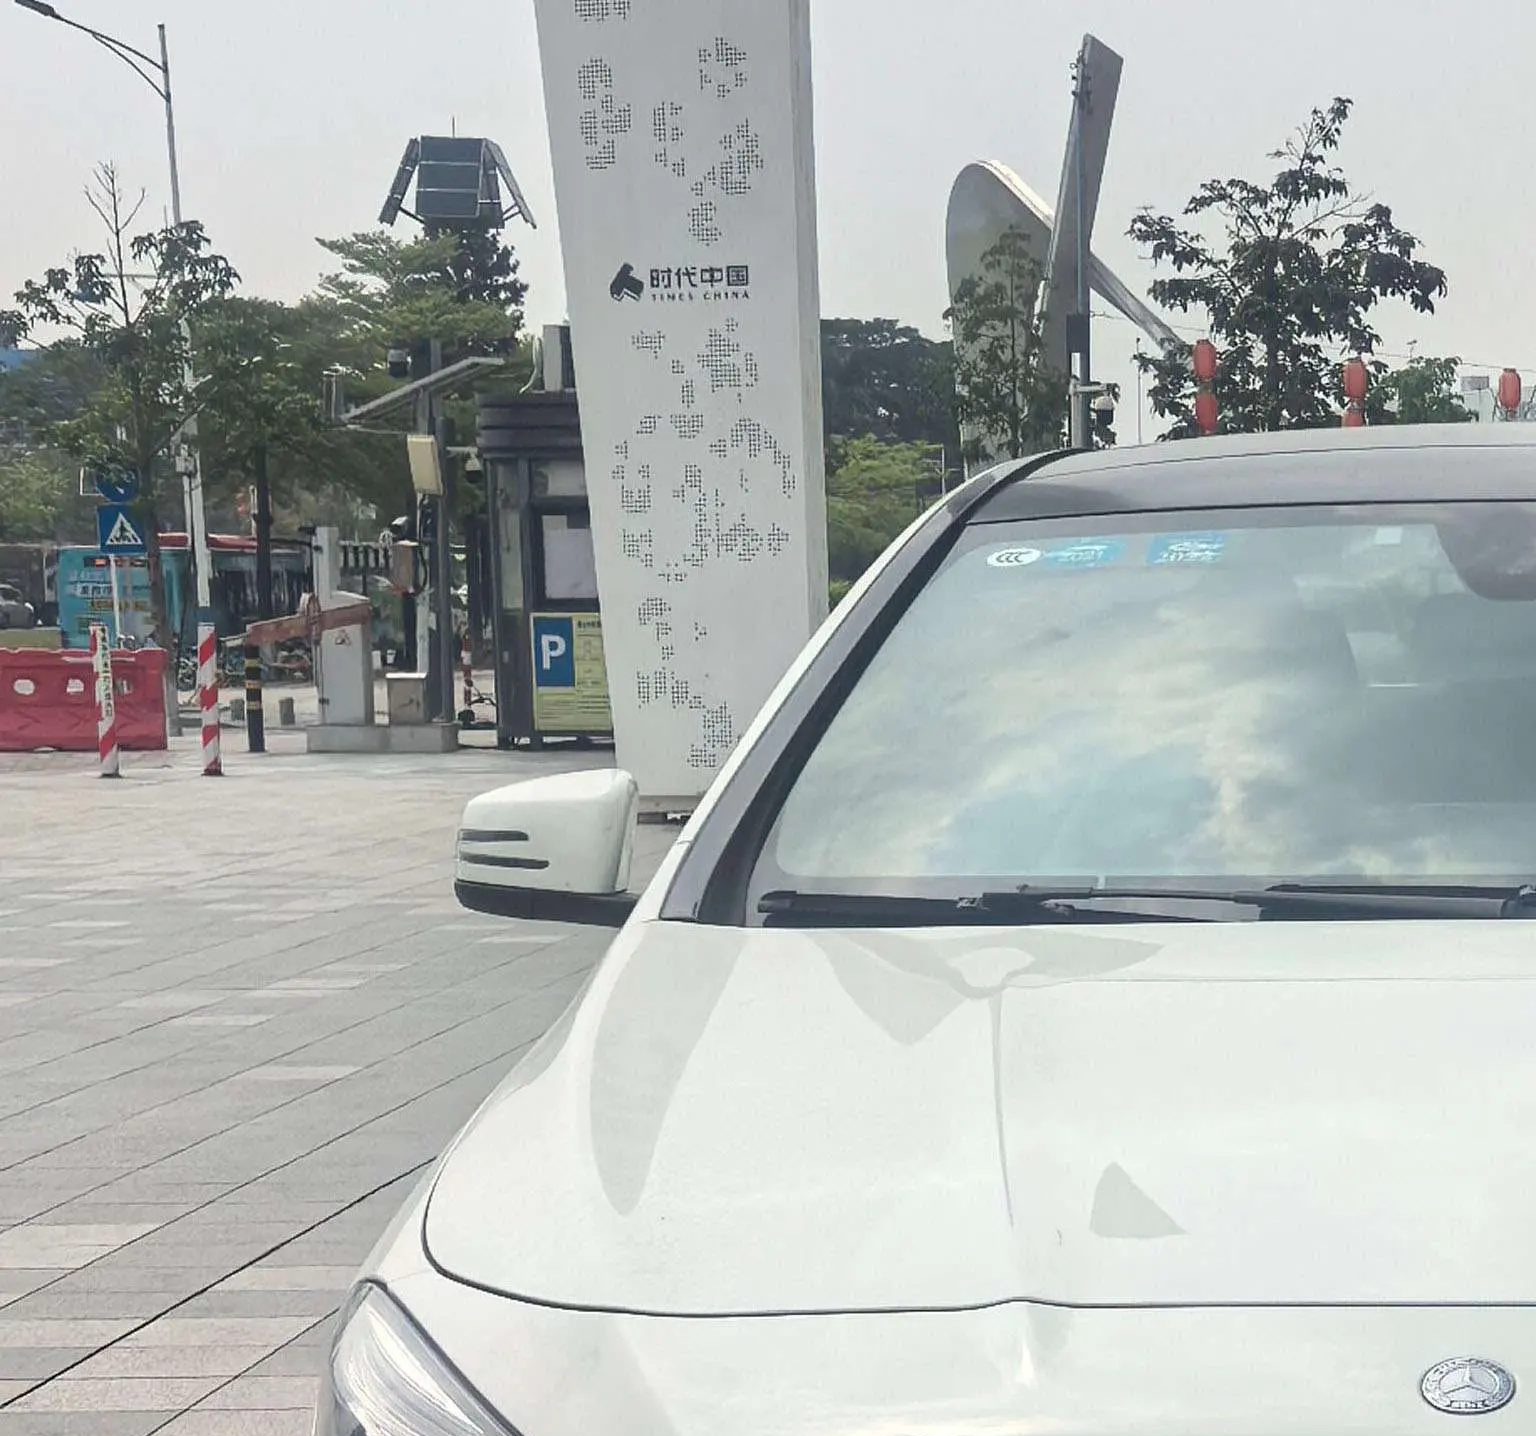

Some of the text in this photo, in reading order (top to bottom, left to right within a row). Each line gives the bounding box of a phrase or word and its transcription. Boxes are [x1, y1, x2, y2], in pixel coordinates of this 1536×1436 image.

[650, 265, 749, 289] 时代中国
[703, 290, 750, 300] CHINA
[541, 634, 566, 670] P
